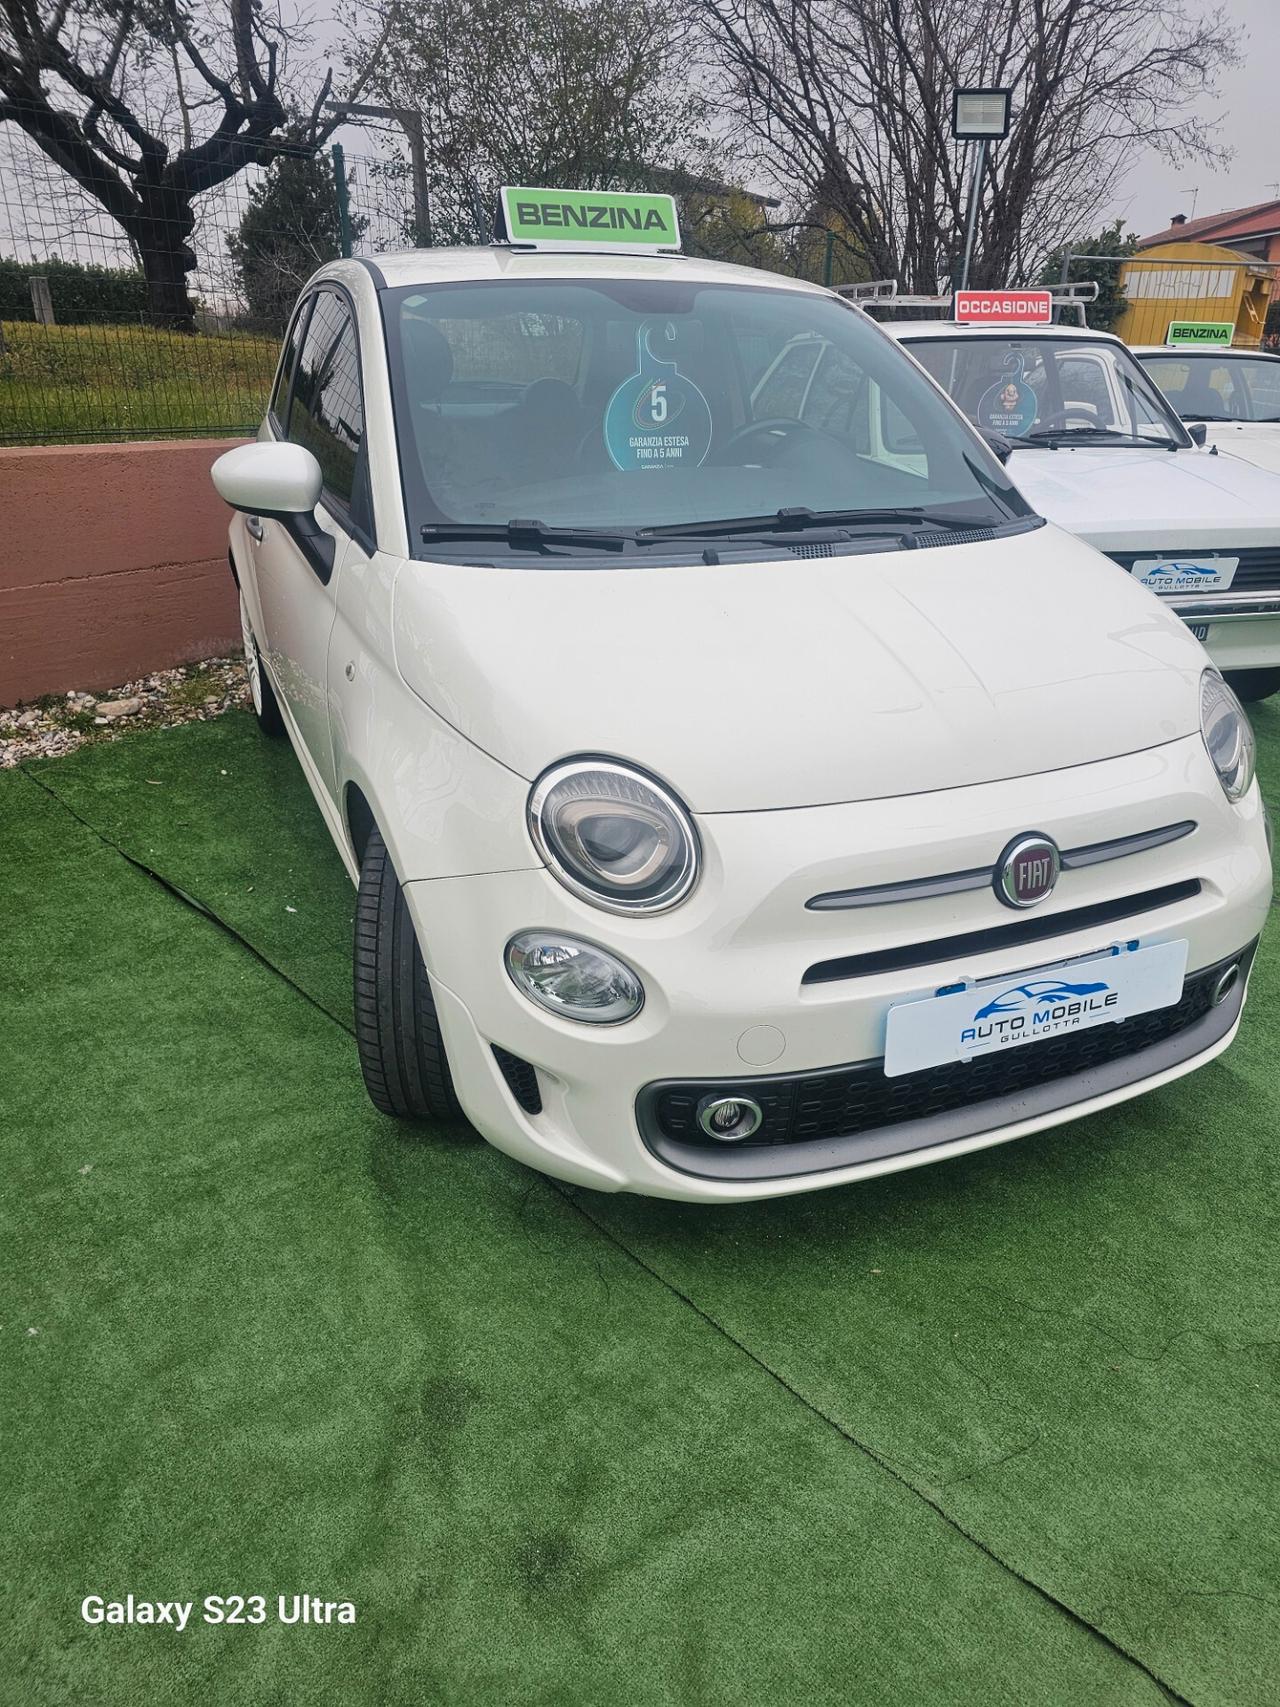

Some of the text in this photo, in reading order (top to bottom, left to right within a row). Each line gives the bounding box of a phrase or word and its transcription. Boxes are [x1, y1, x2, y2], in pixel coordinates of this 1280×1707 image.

[516, 202, 668, 232] BENZINA
[959, 300, 1048, 314] OCCASIONE
[1172, 327, 1229, 339] BENZINA
[651, 385, 668, 422] 5
[629, 436, 690, 448] GARANZIA ESTESA
[636, 447, 682, 458] FINO A 5 ANNI
[1140, 576, 1222, 586] AUTO MOBILE
[1018, 857, 1050, 891] FIAT
[960, 992, 1119, 1043] AUTO MOBILE
[1000, 1017, 1080, 1043] GULLOTTA
